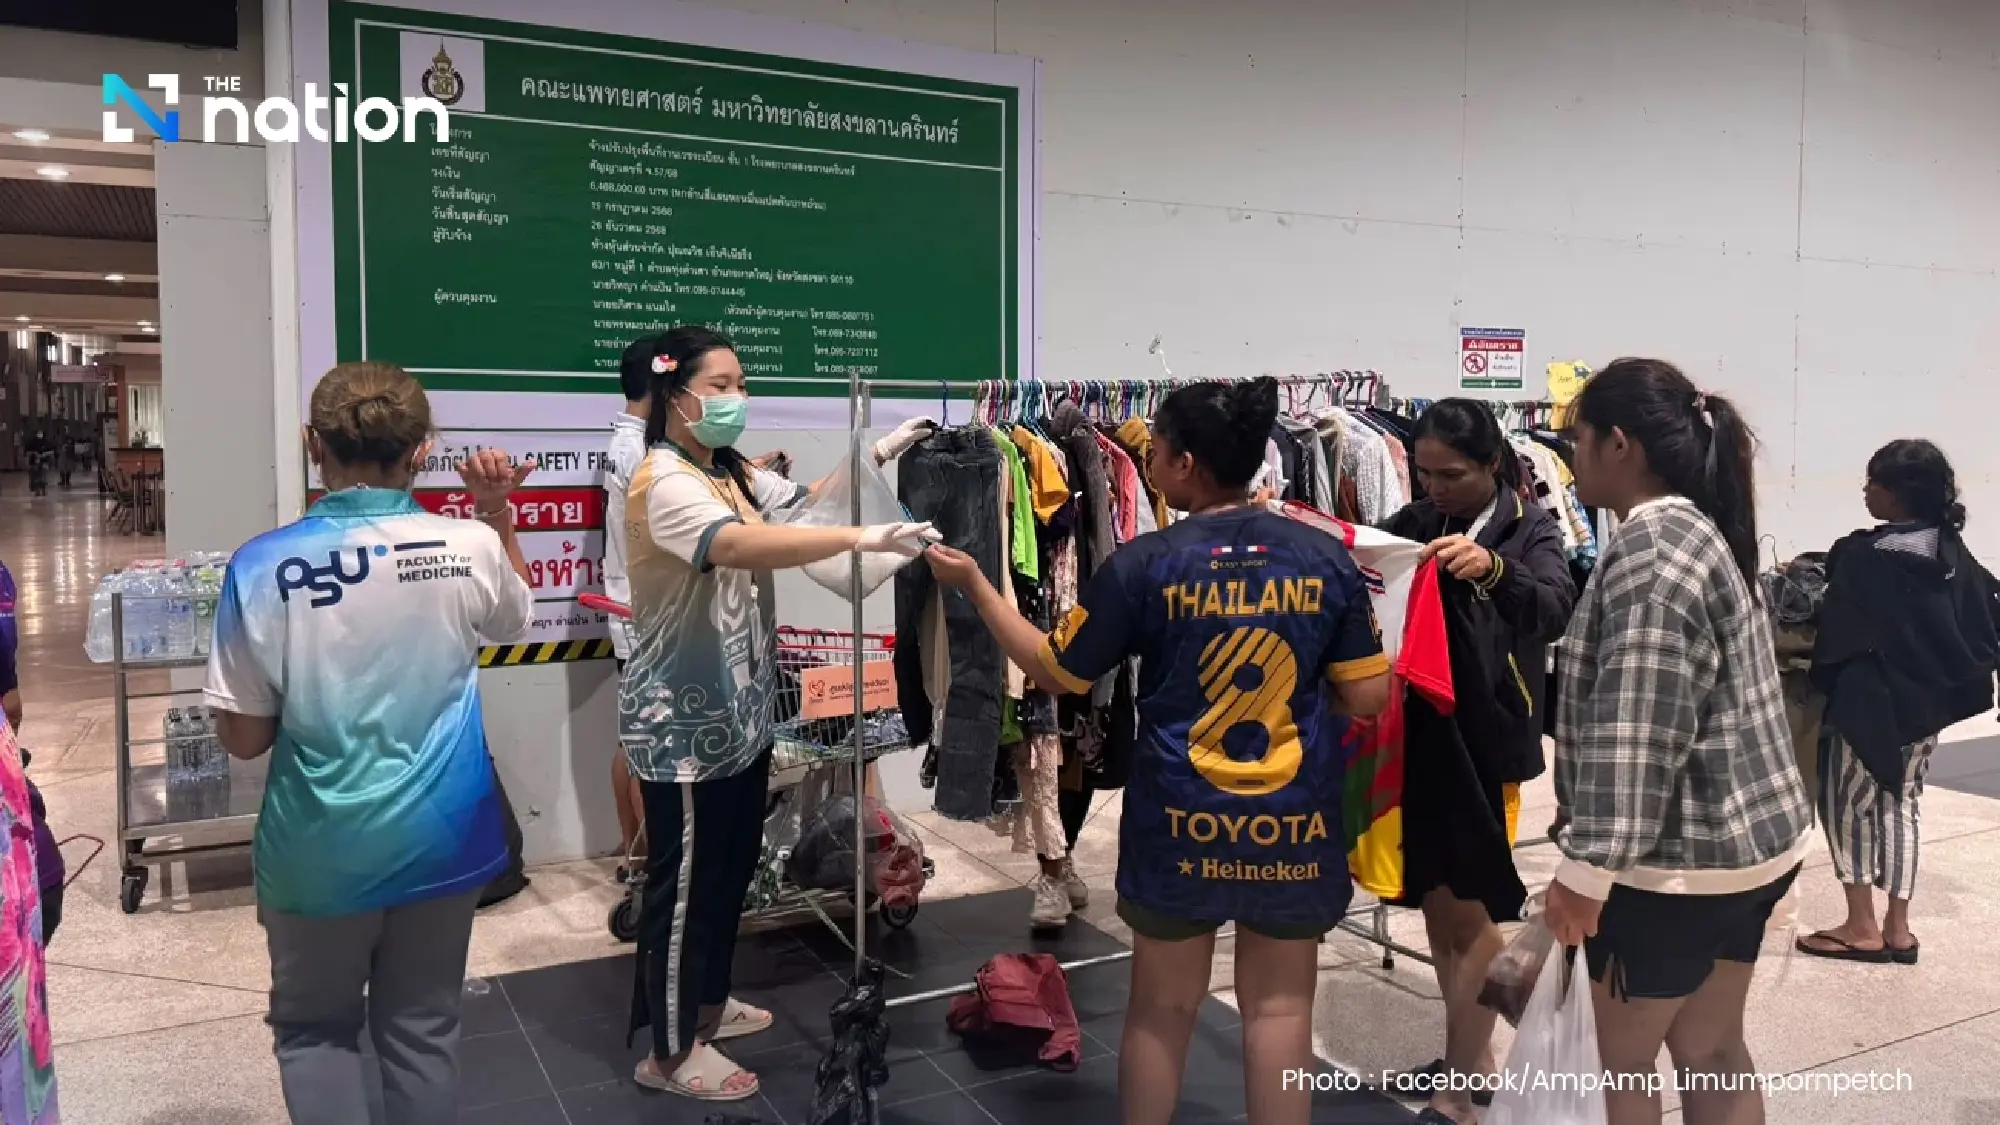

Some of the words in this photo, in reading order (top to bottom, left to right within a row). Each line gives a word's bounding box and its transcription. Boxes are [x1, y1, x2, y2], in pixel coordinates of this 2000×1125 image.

[520, 76, 704, 116] คณะแพทยศาสตร์
[711, 94, 960, 145] มหาวิทยาลัยสงขลานครินทร์
[396, 554, 457, 569] FACULTY
[397, 565, 473, 583] MEDICINE
[1162, 576, 1324, 621] THAILAND
[1187, 625, 1303, 796] 8
[1164, 805, 1328, 846] TOYOTA
[1200, 857, 1320, 881] Heineken
